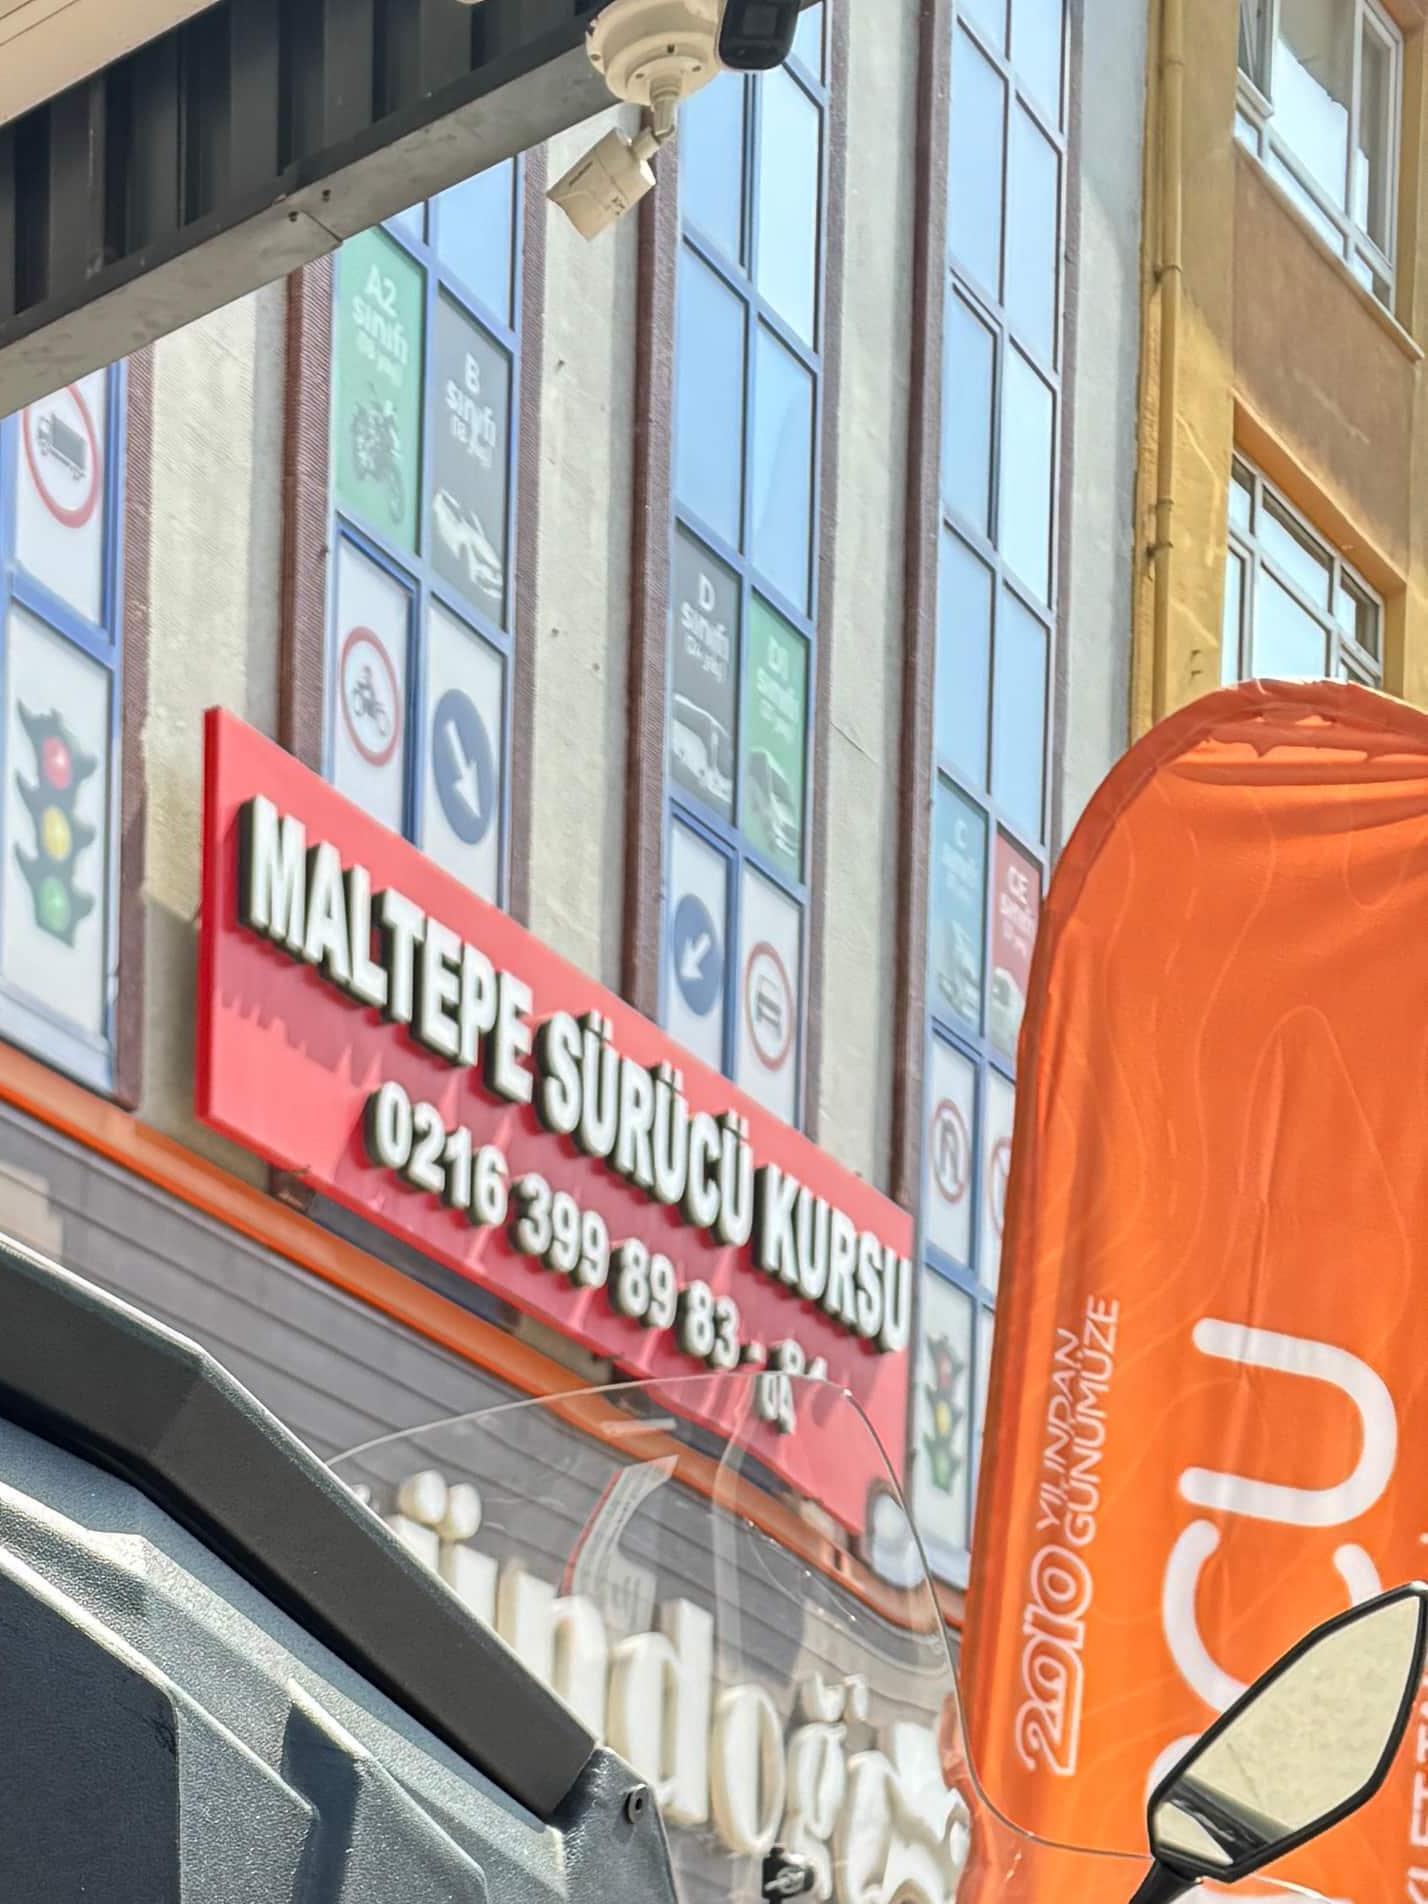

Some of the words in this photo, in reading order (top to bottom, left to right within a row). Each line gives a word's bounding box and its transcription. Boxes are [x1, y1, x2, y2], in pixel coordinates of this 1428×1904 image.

[464, 352, 480, 395] B
[699, 573, 715, 612] D
[244, 795, 533, 1103] MALTEPE
[542, 1010, 753, 1246] SÜRÜCÜ
[756, 1164, 911, 1353] KURSU
[374, 1081, 508, 1228] 0216
[516, 1173, 609, 1288] 399
[616, 1237, 677, 1329] 89
[684, 1280, 740, 1369] 83
[1036, 1327, 1081, 1533] YILINDAN
[1064, 1293, 1120, 1548] GÜNÜMÜZE
[1015, 1543, 1094, 1778] 2010
